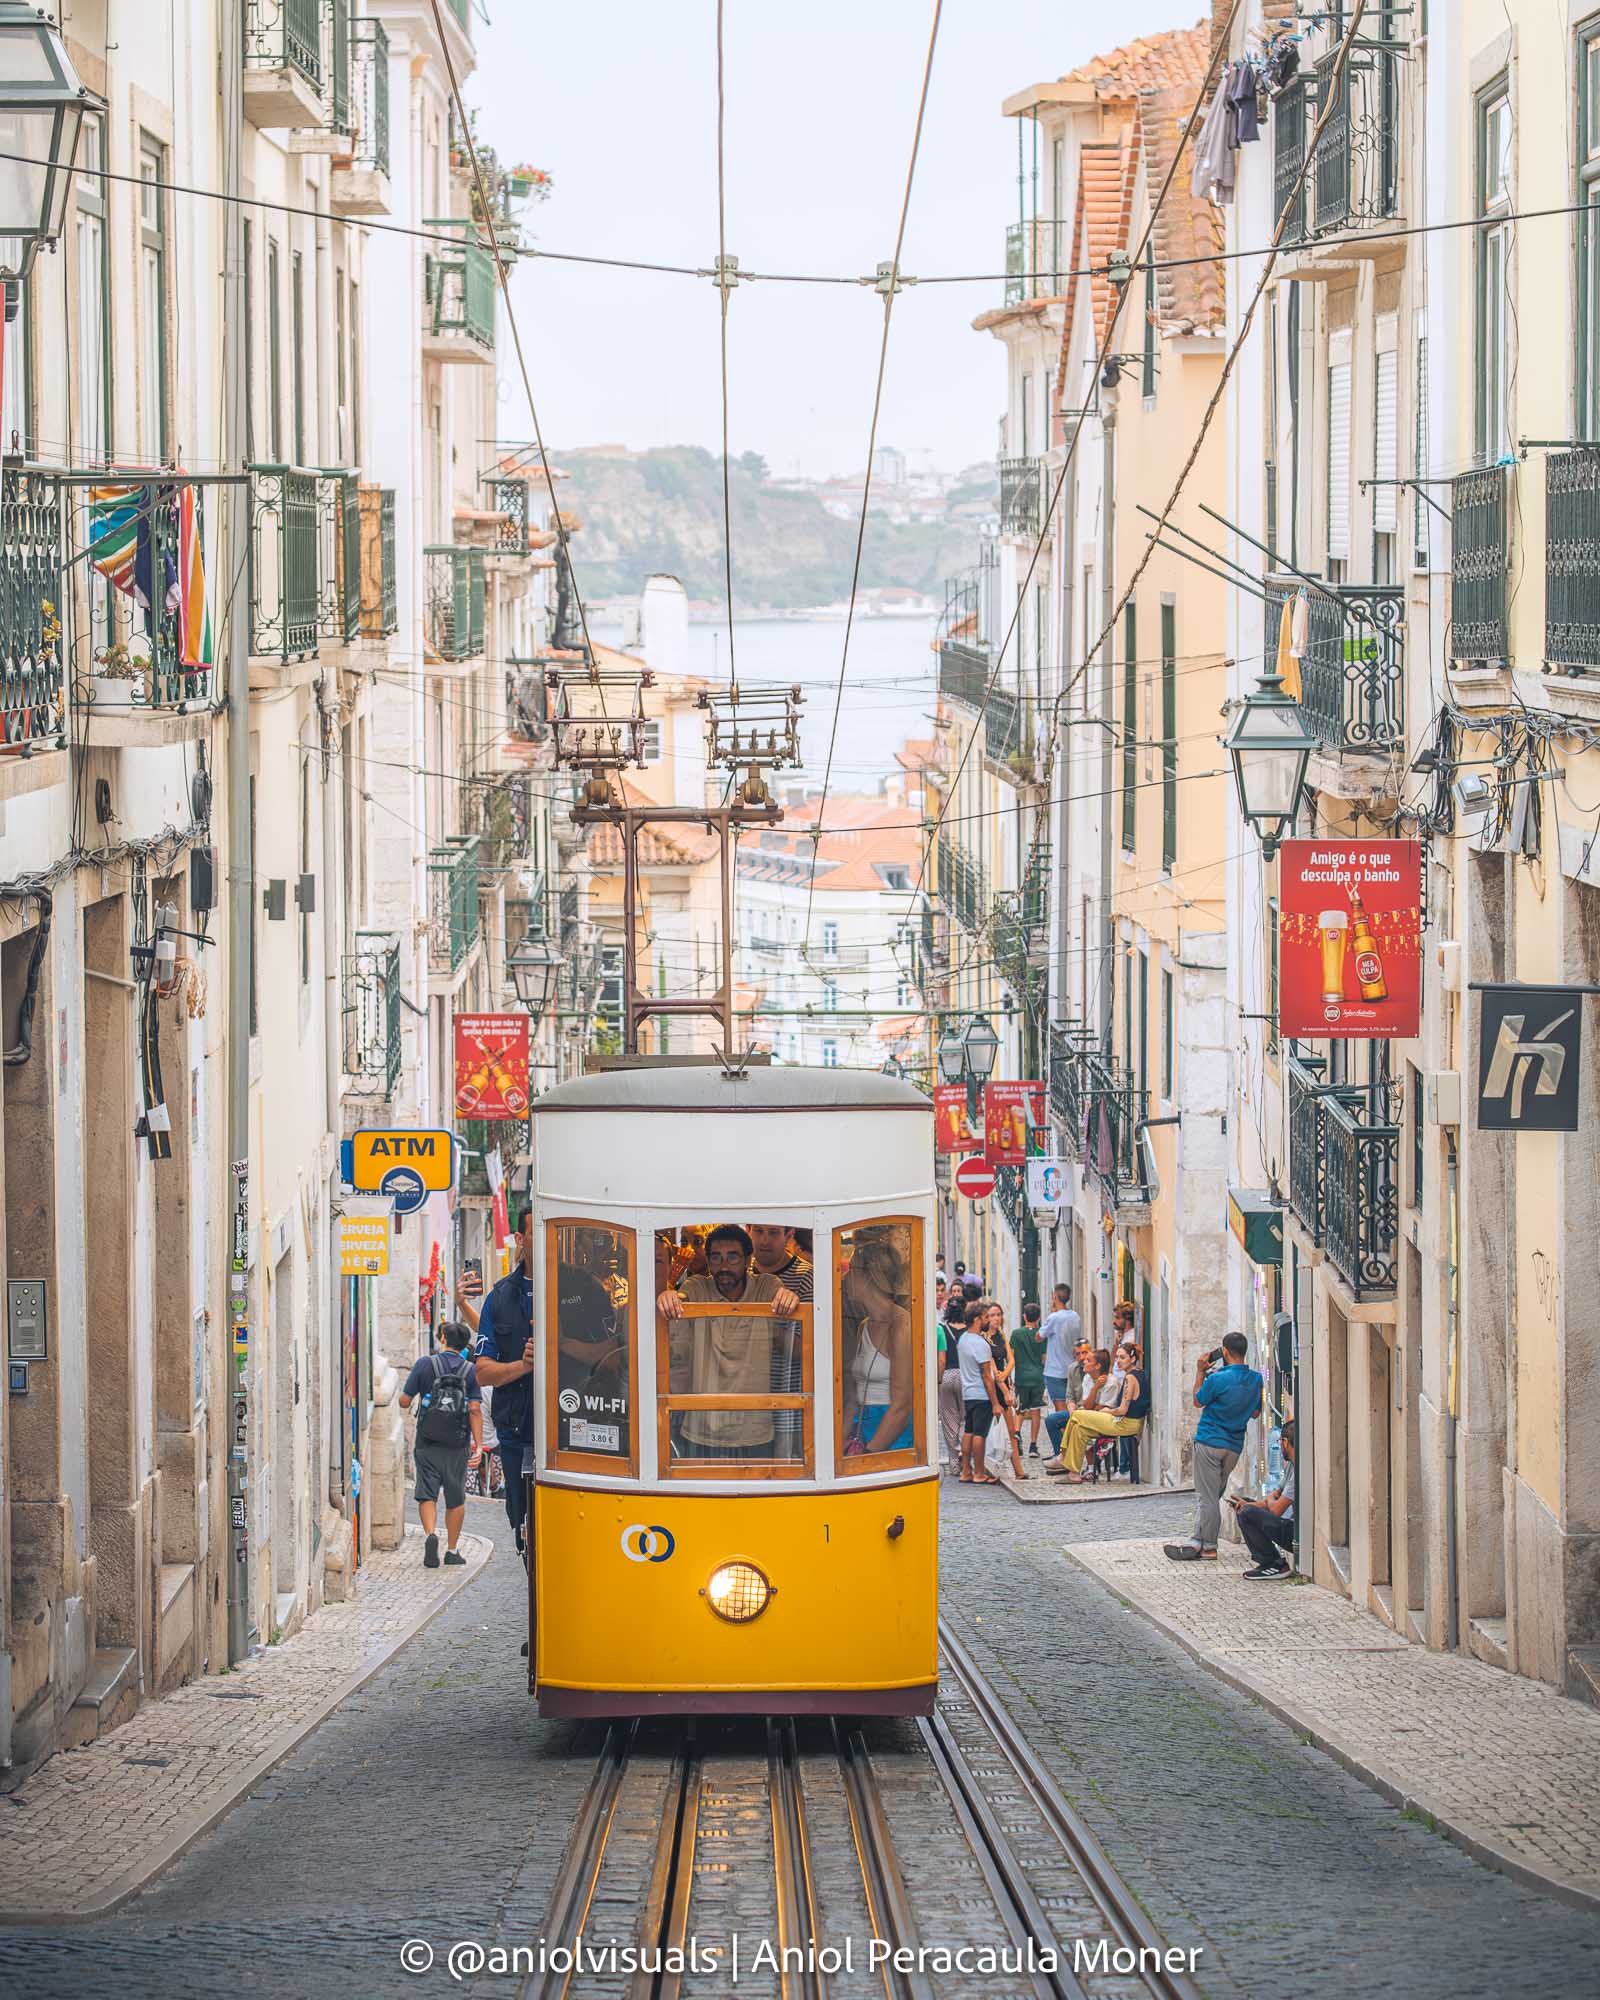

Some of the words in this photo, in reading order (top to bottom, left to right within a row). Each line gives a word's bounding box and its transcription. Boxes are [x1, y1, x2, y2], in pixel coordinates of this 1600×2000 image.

[1310, 851, 1346, 868] Amigo
[1349, 851, 1357, 865] é
[1359, 854, 1367, 865] o
[1369, 853, 1391, 868] que
[1301, 869, 1350, 886] desculpa
[1354, 870, 1361, 882] o
[1364, 868, 1400, 882] banho
[1360, 965, 1379, 976] CULPA
[369, 1138, 435, 1156] ATM
[340, 1224, 384, 1235] ERVEJA
[339, 1241, 385, 1251] ERVEZA
[584, 1395, 626, 1414] WI-FI
[591, 1433, 607, 1443] 3.80
[608, 1436, 614, 1444] €
[232, 1499, 244, 1527] FELON
[823, 1524, 830, 1544] 1
